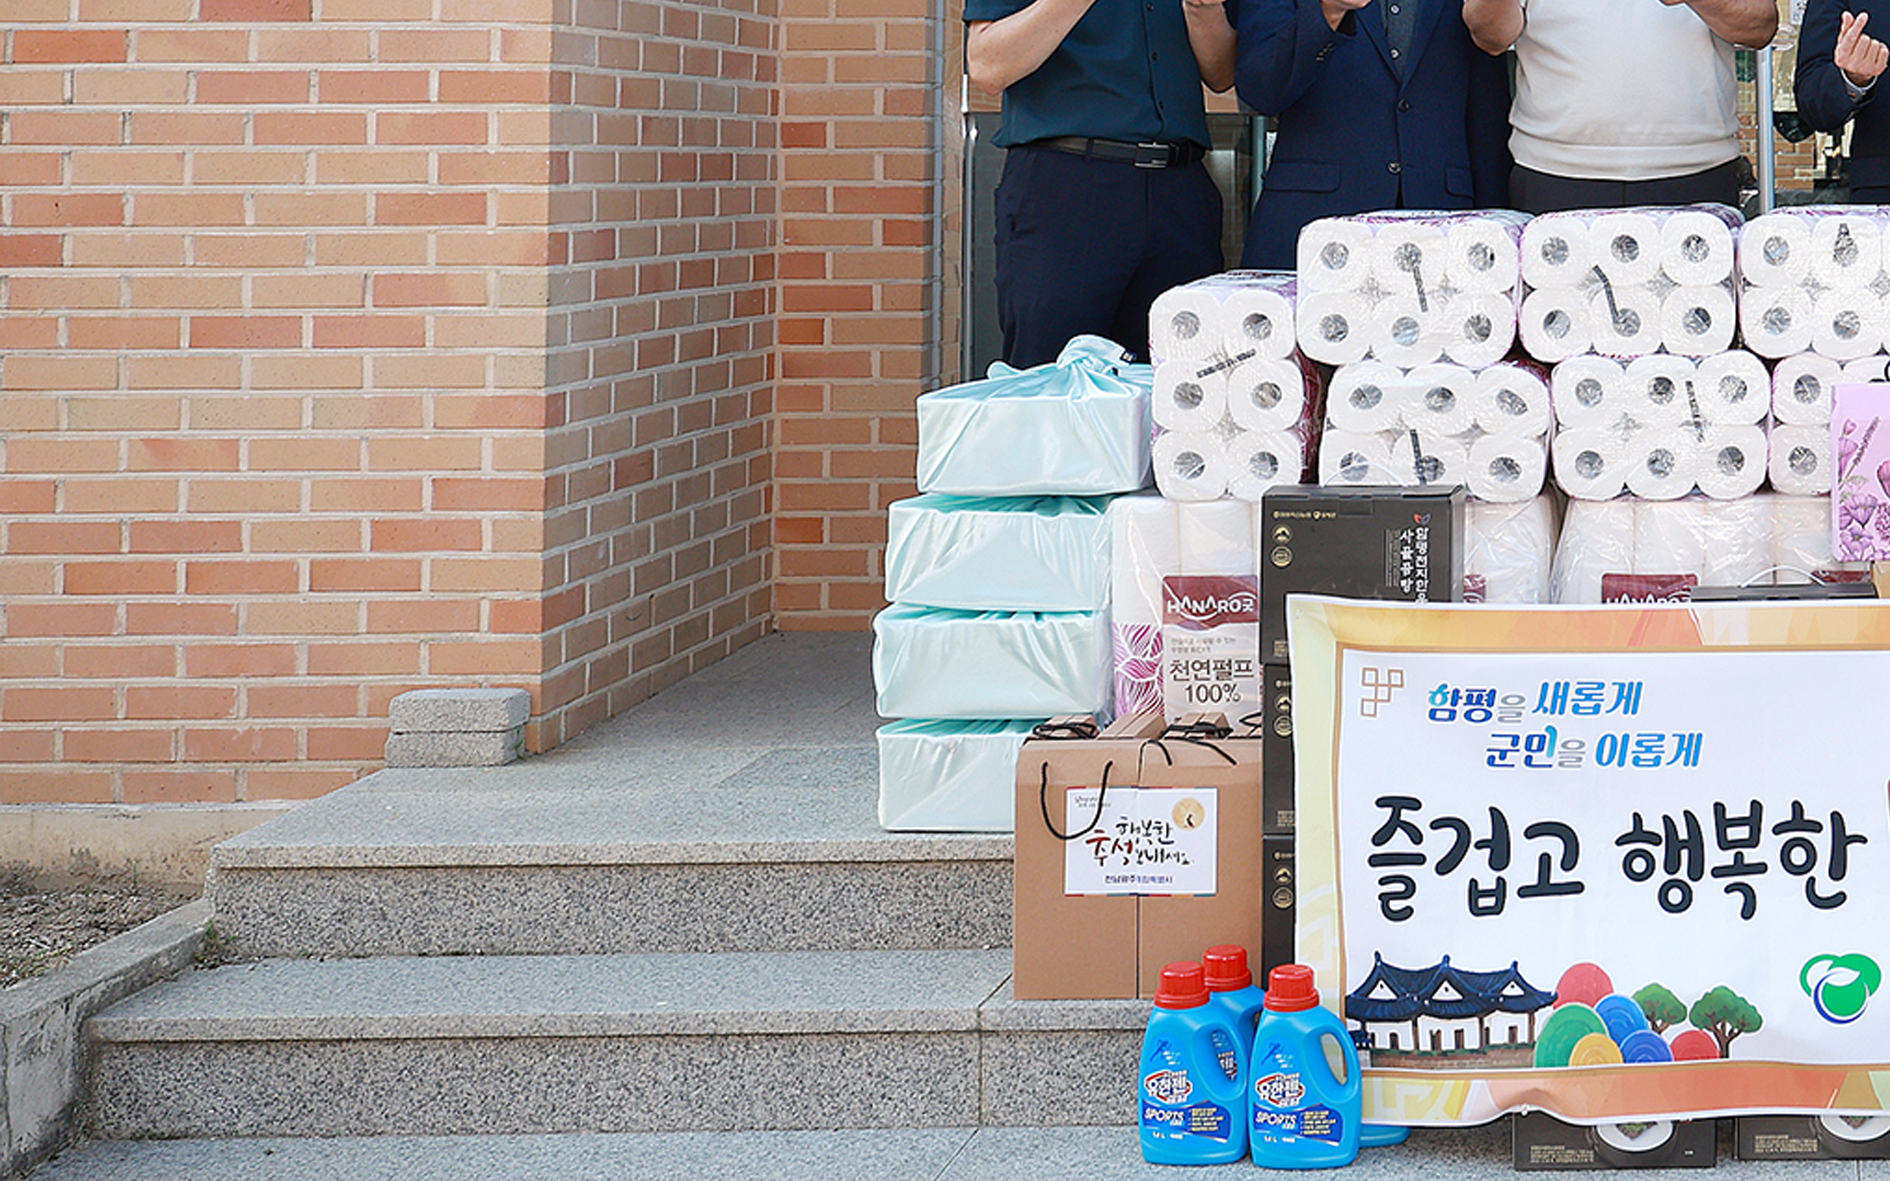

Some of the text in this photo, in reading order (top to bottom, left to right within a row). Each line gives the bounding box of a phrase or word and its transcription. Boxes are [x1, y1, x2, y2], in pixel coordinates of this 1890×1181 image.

[1169, 658, 1255, 682] 천연펄프
[1184, 683, 1241, 704] 100%
[1427, 679, 1644, 723] 함평을 새롭게
[1485, 725, 1704, 769] 군민을 이롭게
[1115, 816, 1175, 846] 행복한
[1085, 829, 1135, 867] 추석
[1366, 794, 1585, 922] 즐겁고
[1615, 798, 1868, 921] 행복한
[1144, 1107, 1186, 1122] SPORTS
[1255, 1111, 1298, 1125] SPORTS
